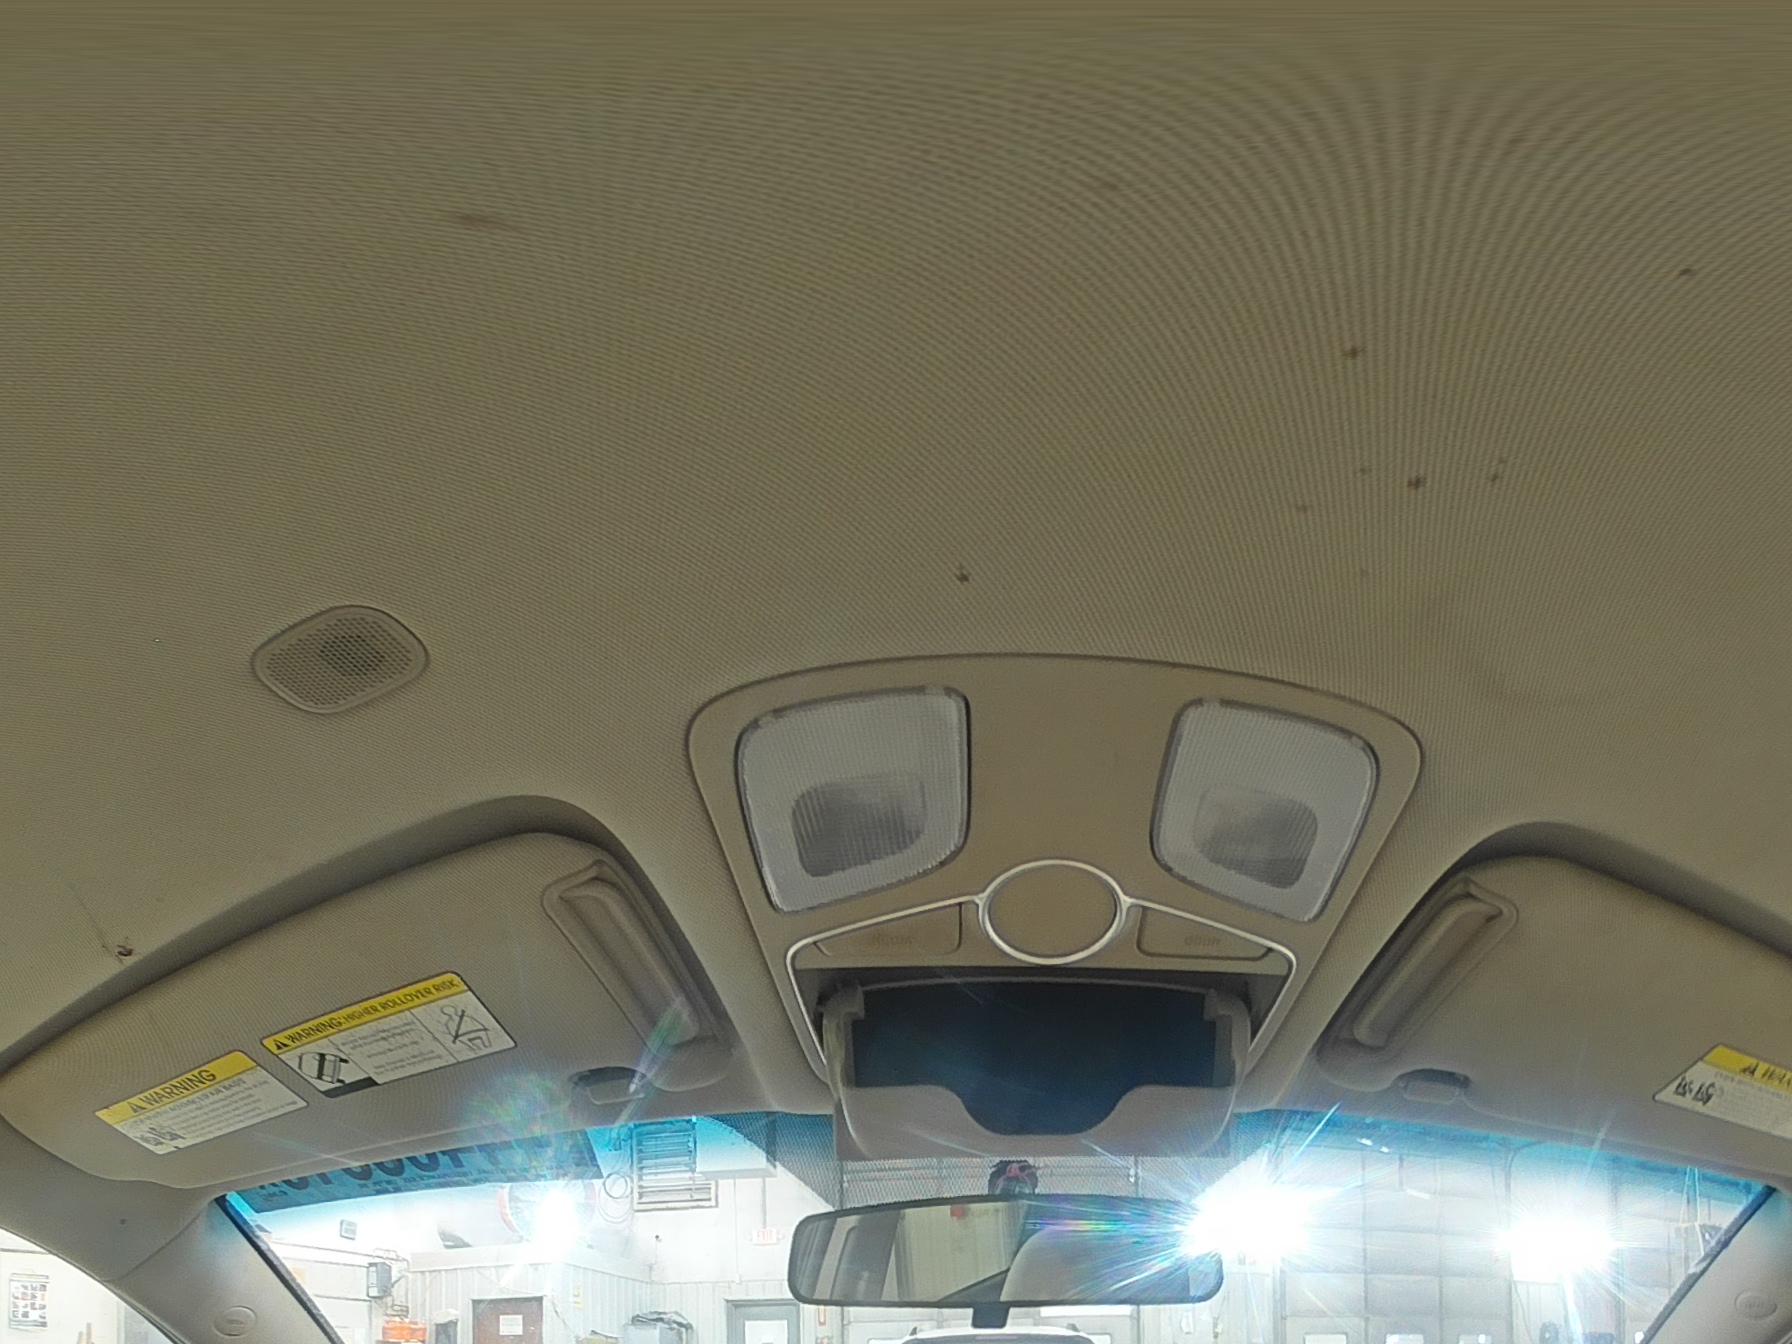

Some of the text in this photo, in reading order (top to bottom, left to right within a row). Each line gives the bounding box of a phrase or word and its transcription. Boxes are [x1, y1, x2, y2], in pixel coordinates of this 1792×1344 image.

[342, 1002, 381, 1024] HIGHER
[380, 986, 434, 1012] ROLLOVER
[431, 977, 460, 994] RISK
[139, 1068, 218, 1107] WARNING
